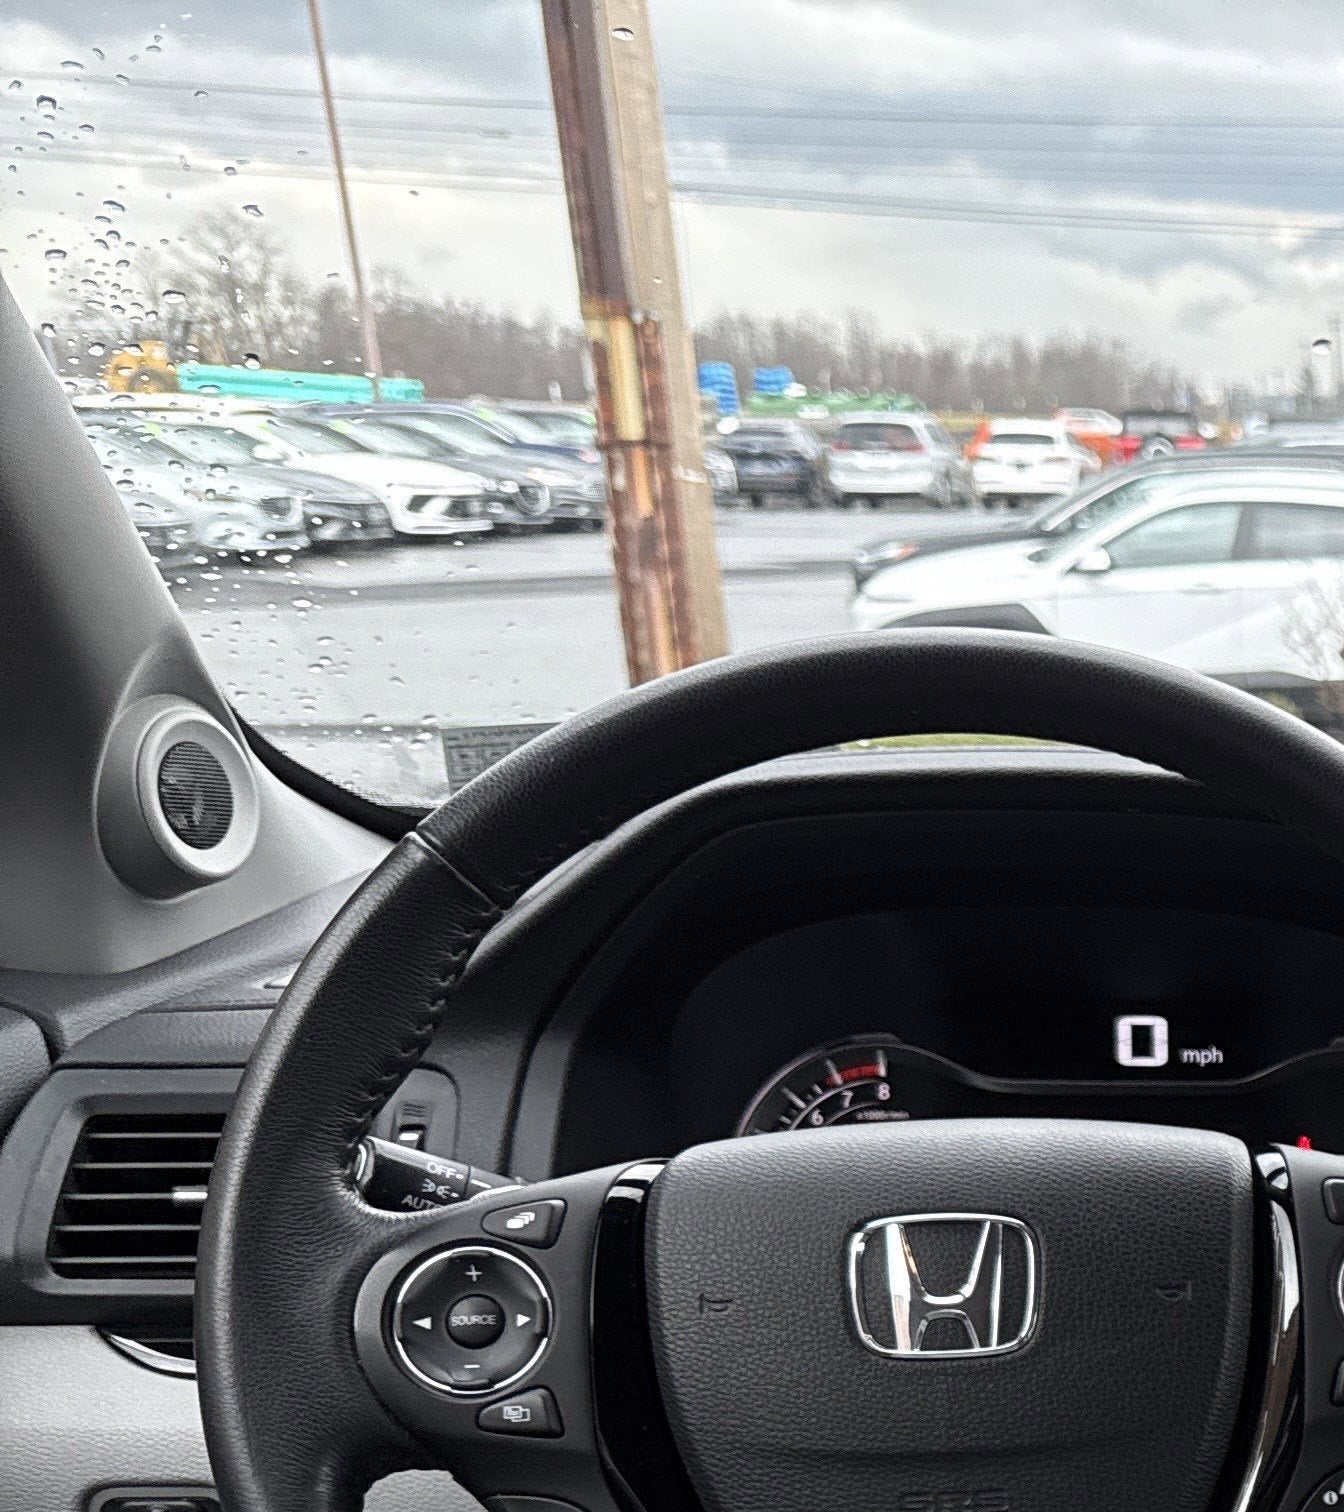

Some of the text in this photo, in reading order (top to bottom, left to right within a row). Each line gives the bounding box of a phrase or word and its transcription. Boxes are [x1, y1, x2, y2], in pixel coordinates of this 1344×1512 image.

[1113, 1014, 1224, 1067] 0 mph
[840, 1089, 854, 1109] 7
[877, 1081, 891, 1101] 8
[811, 1108, 825, 1126] 6
[426, 1161, 458, 1179] OFF
[401, 1194, 440, 1210] AUT
[451, 1314, 498, 1328] SOURCE
